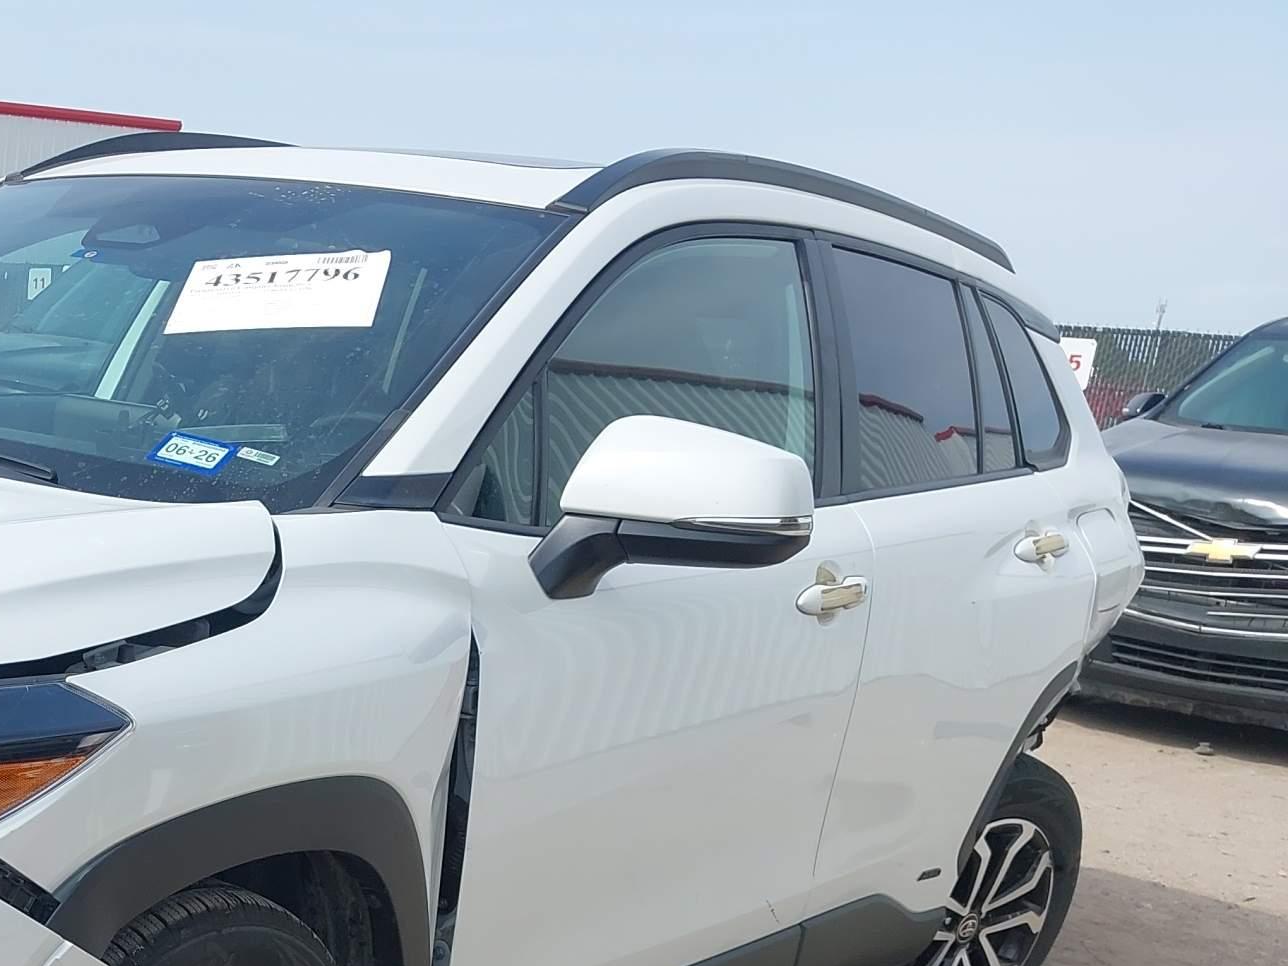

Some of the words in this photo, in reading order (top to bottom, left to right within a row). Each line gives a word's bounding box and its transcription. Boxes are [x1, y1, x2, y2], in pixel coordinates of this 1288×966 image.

[32, 277, 46, 289] 11
[204, 266, 364, 287] 43517796
[1068, 354, 1083, 372] 5
